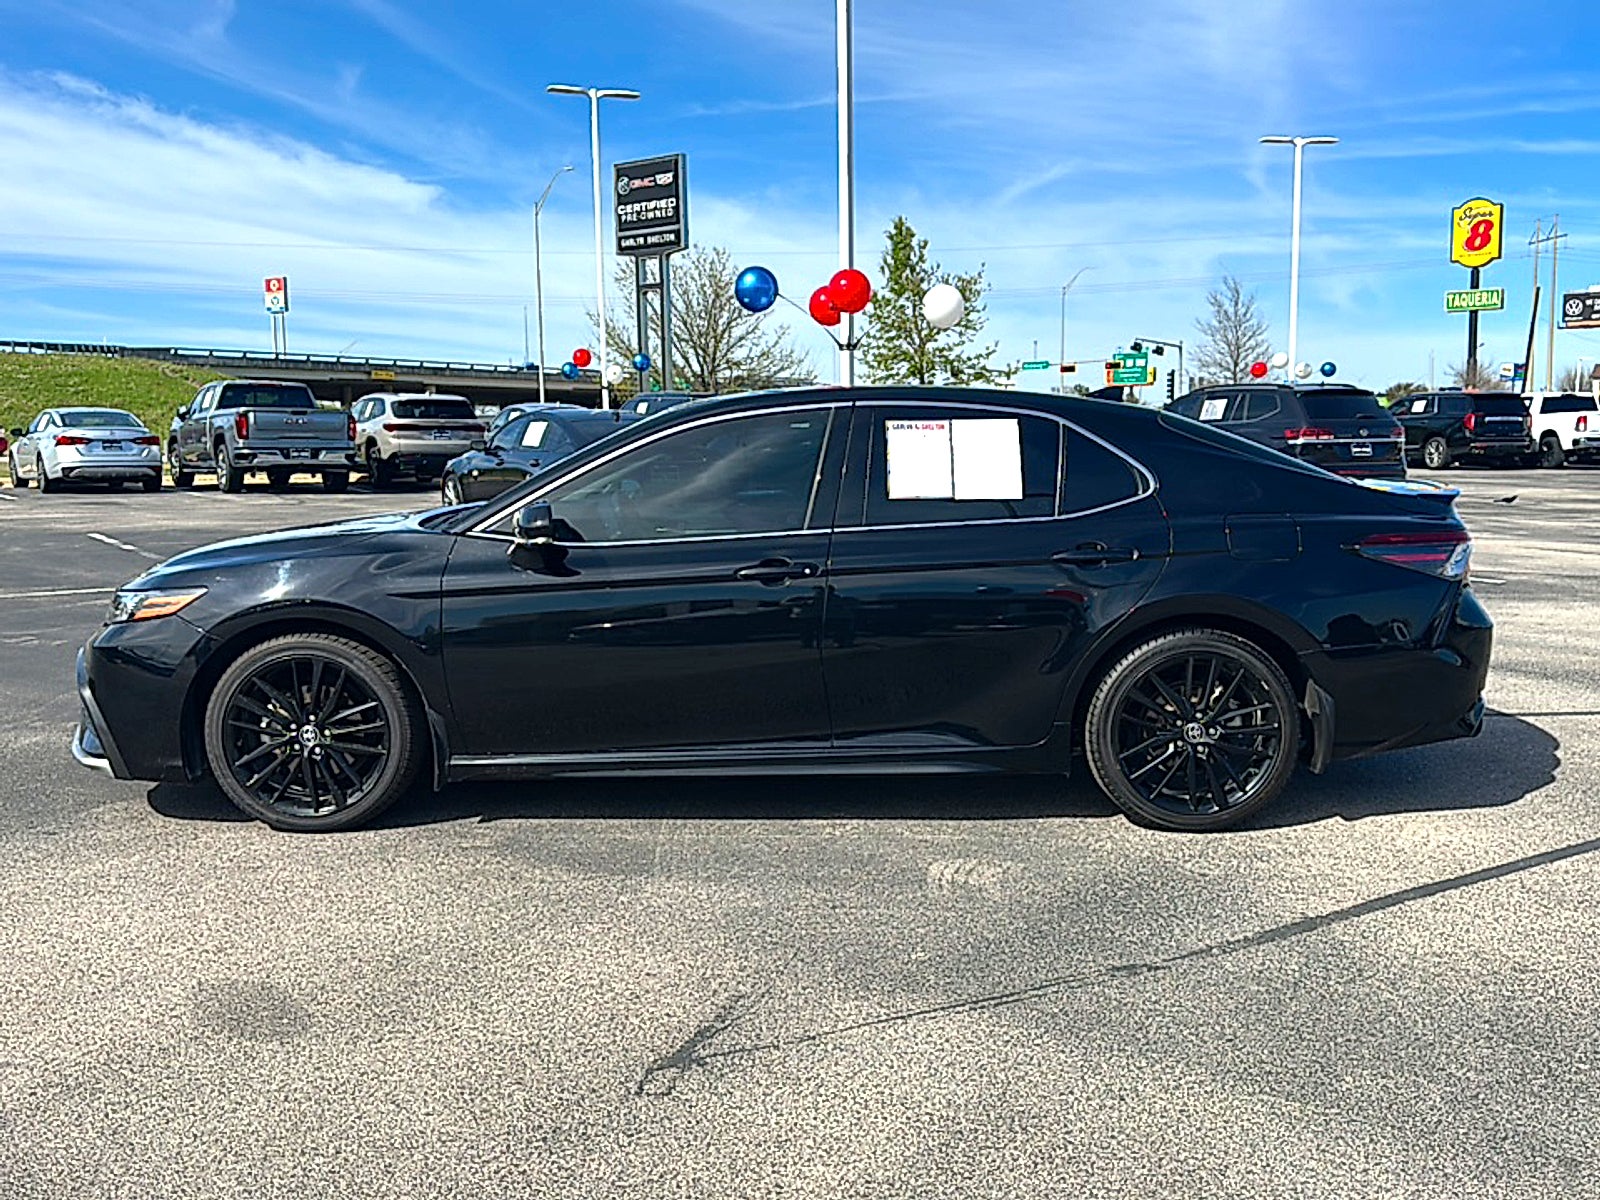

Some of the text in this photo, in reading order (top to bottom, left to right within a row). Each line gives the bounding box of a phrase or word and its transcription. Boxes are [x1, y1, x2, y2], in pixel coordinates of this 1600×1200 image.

[617, 198, 676, 215] CERTIFIED
[1459, 206, 1494, 226] Super
[1464, 219, 1493, 251] 8
[1447, 291, 1499, 308] TAQUERIA
